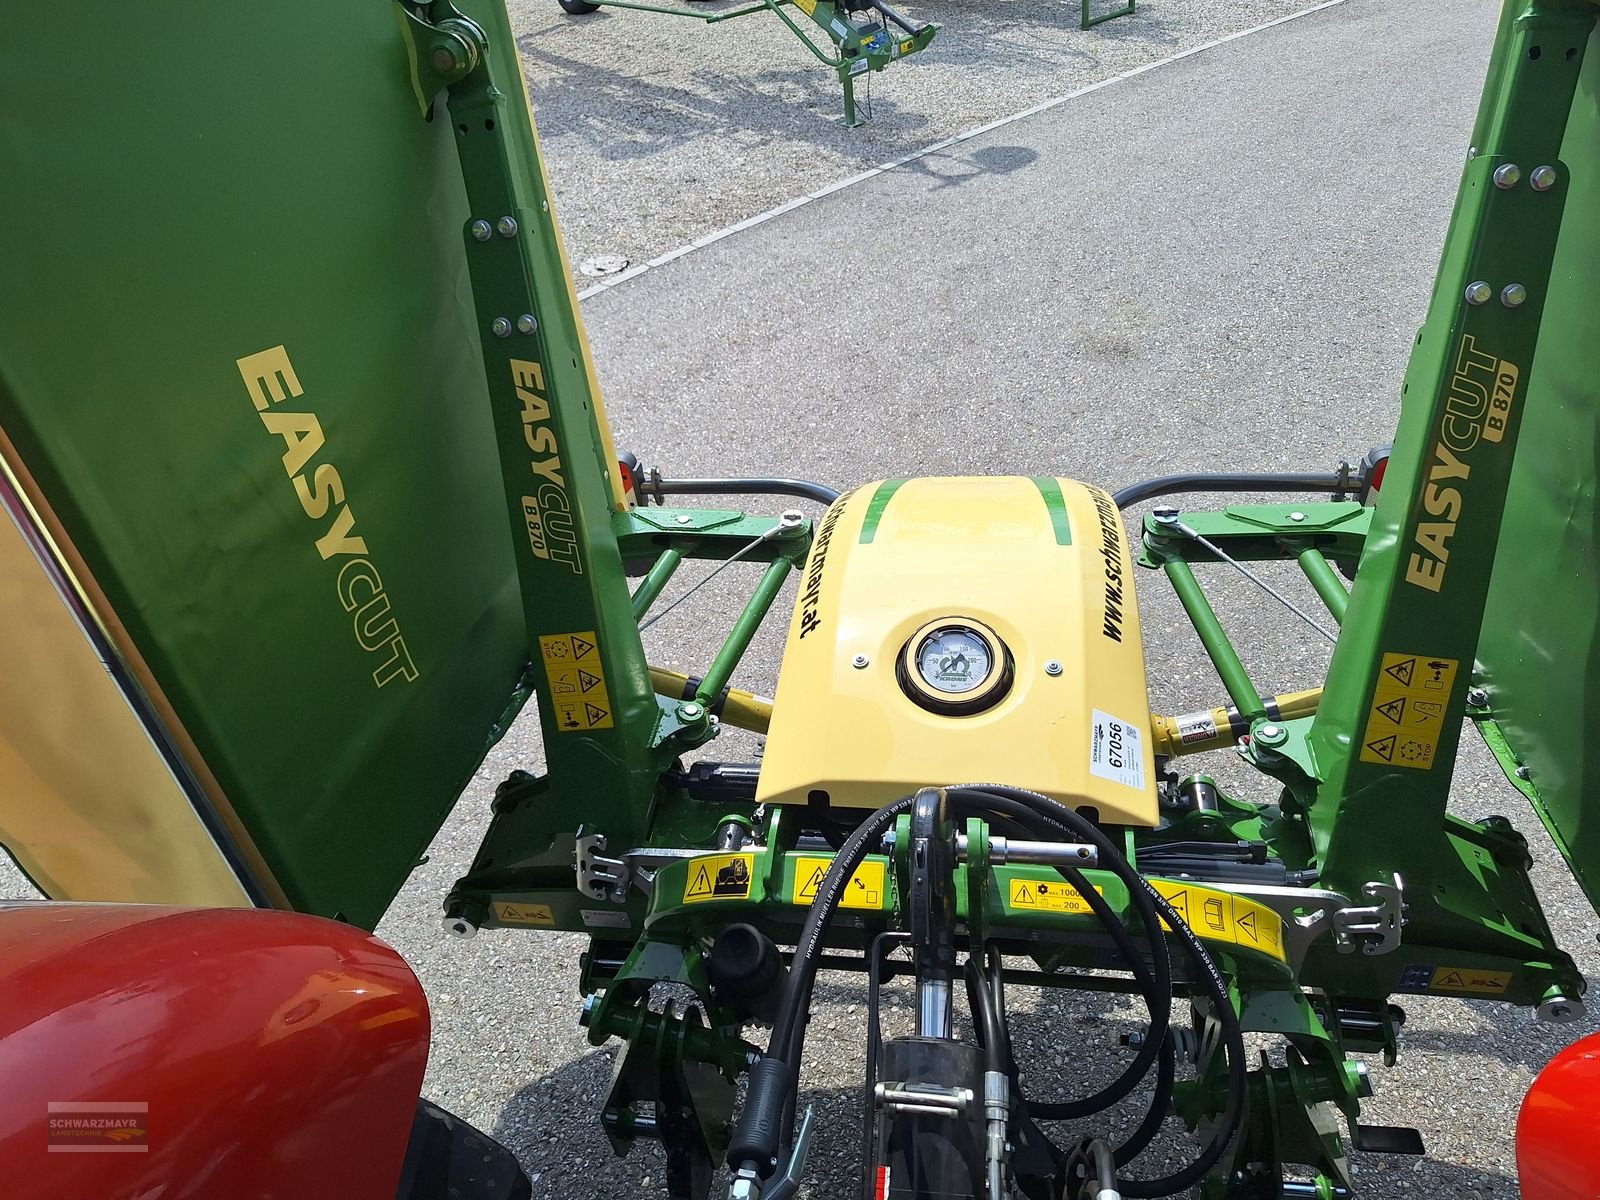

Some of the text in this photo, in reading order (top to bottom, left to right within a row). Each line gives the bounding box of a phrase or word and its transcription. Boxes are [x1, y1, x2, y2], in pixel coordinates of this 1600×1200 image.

[1487, 373, 1515, 432] B 870
[510, 358, 583, 575] EASYCUT
[1405, 333, 1498, 593] EASYCUT
[236, 344, 419, 689] EASYCUT
[524, 504, 544, 551] B 870
[543, 642, 552, 659] STOP
[1109, 722, 1122, 768] 67056
[1422, 743, 1432, 762] STOP
[805, 919, 823, 959] HYDRAULIK
[819, 889, 835, 920] MUELLER
[831, 867, 846, 891] RHEINE
[1064, 901, 1080, 910] 200
[1168, 907, 1183, 925] DN10
[1194, 940, 1203, 952] WP
[1200, 950, 1211, 964] 330
[1207, 962, 1219, 979] BAR
